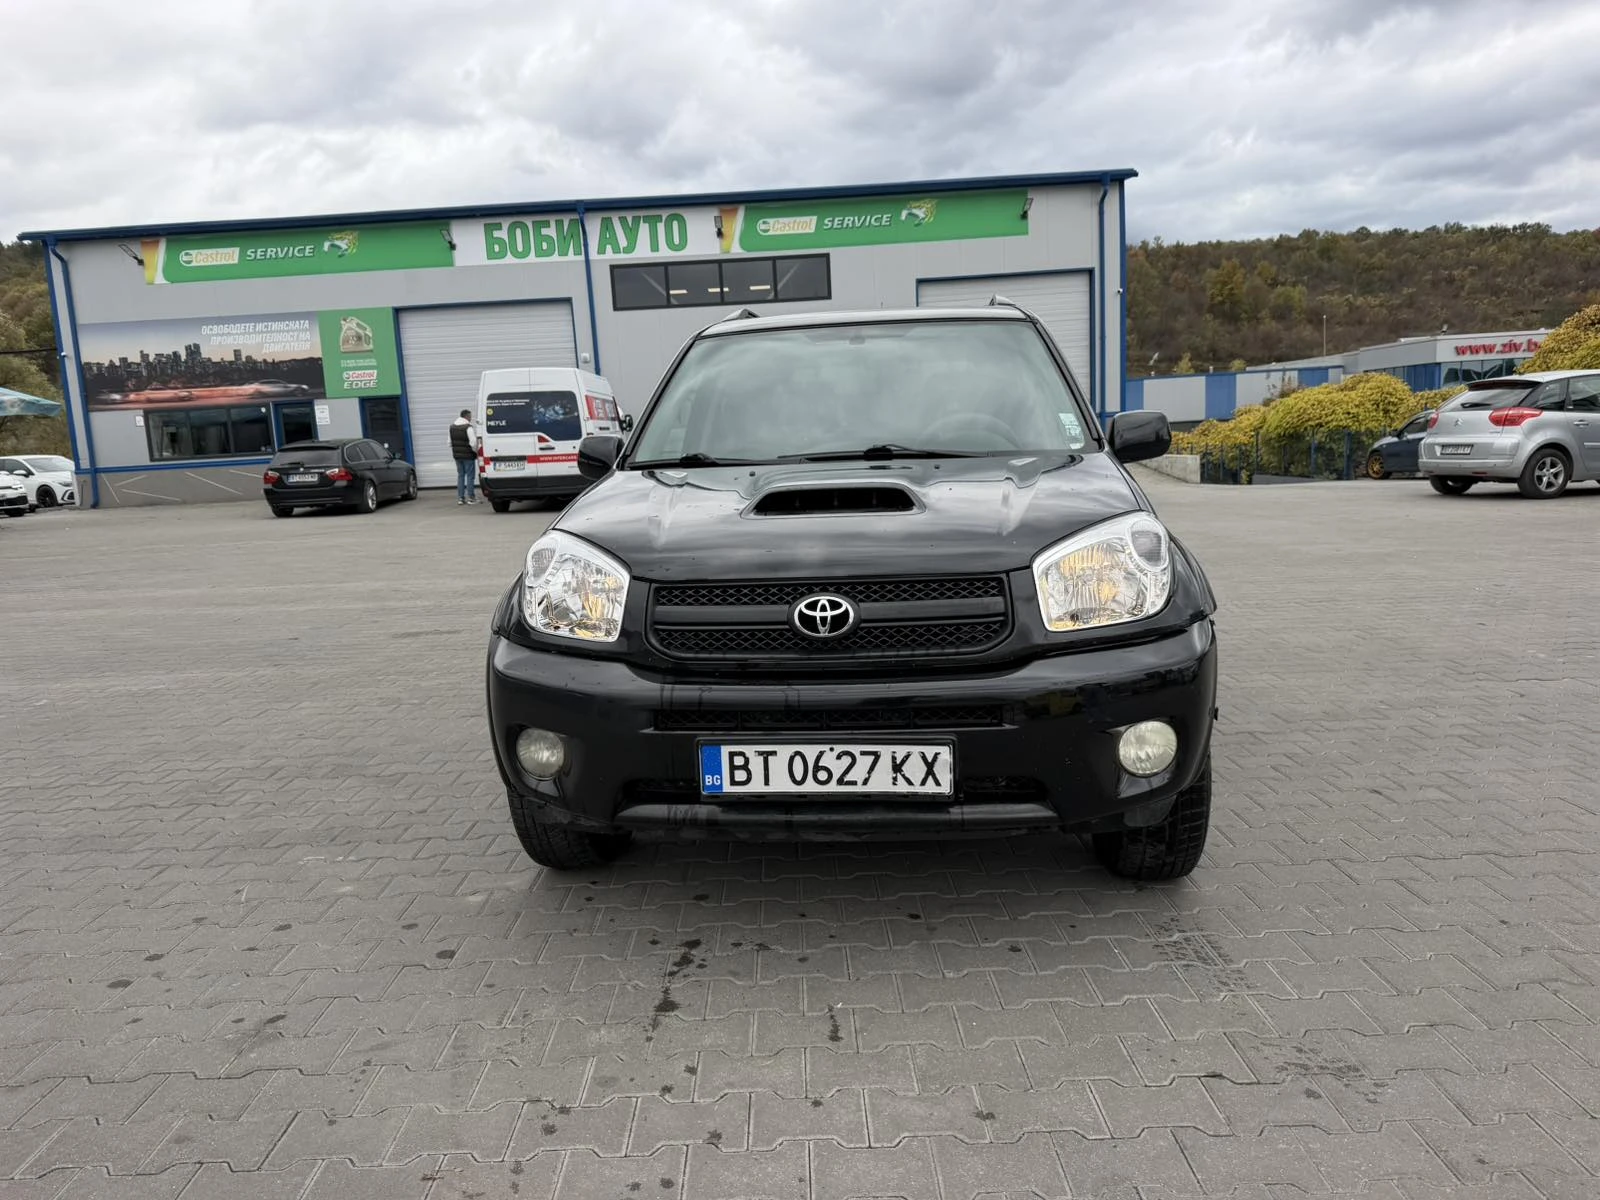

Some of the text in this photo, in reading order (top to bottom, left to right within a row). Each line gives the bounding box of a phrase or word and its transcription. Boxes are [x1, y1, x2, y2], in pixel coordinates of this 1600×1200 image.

[771, 214, 891, 233] Castrol SERVICE
[483, 212, 688, 260] БОБИ АУТО
[194, 245, 314, 264] Castrol SERVICE
[1455, 338, 1540, 356] www.ziv.b
[344, 380, 378, 389] EDGE
[351, 371, 376, 379] Castrol
[705, 750, 942, 787] BG BT 0627 KX
